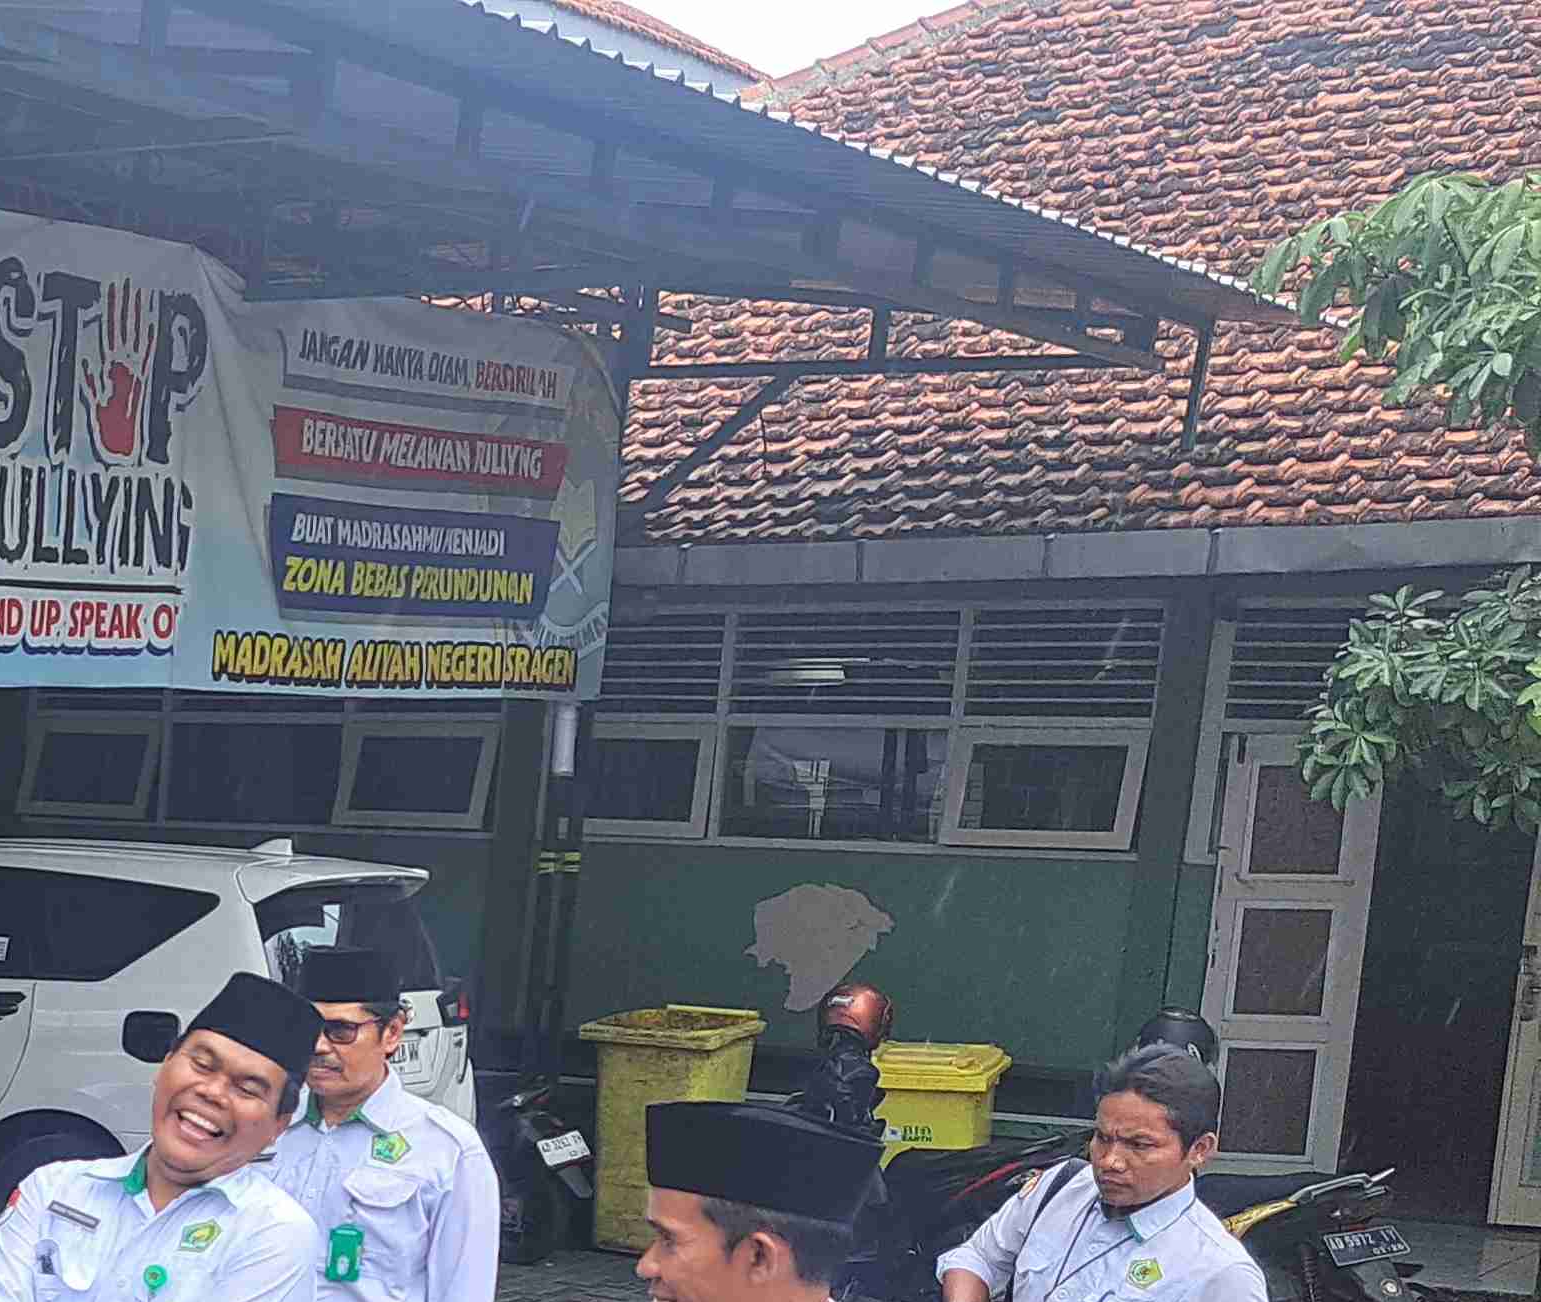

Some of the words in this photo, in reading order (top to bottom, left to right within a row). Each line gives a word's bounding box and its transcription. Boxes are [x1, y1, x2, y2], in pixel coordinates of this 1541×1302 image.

[300, 328, 370, 370] JANGAN
[373, 344, 424, 381] HANYA
[303, 419, 377, 464] BERSATU
[379, 431, 471, 473] MELAWAN
[291, 513, 335, 545] BUAT
[283, 556, 346, 593] ZONA
[351, 560, 410, 598] BEBAS
[68, 602, 145, 639] SPEAK
[214, 631, 344, 686] MADRASAH
[345, 640, 422, 687] ALIYAH
[425, 641, 503, 689] NEGERI
[504, 642, 578, 691] SRAGEN
